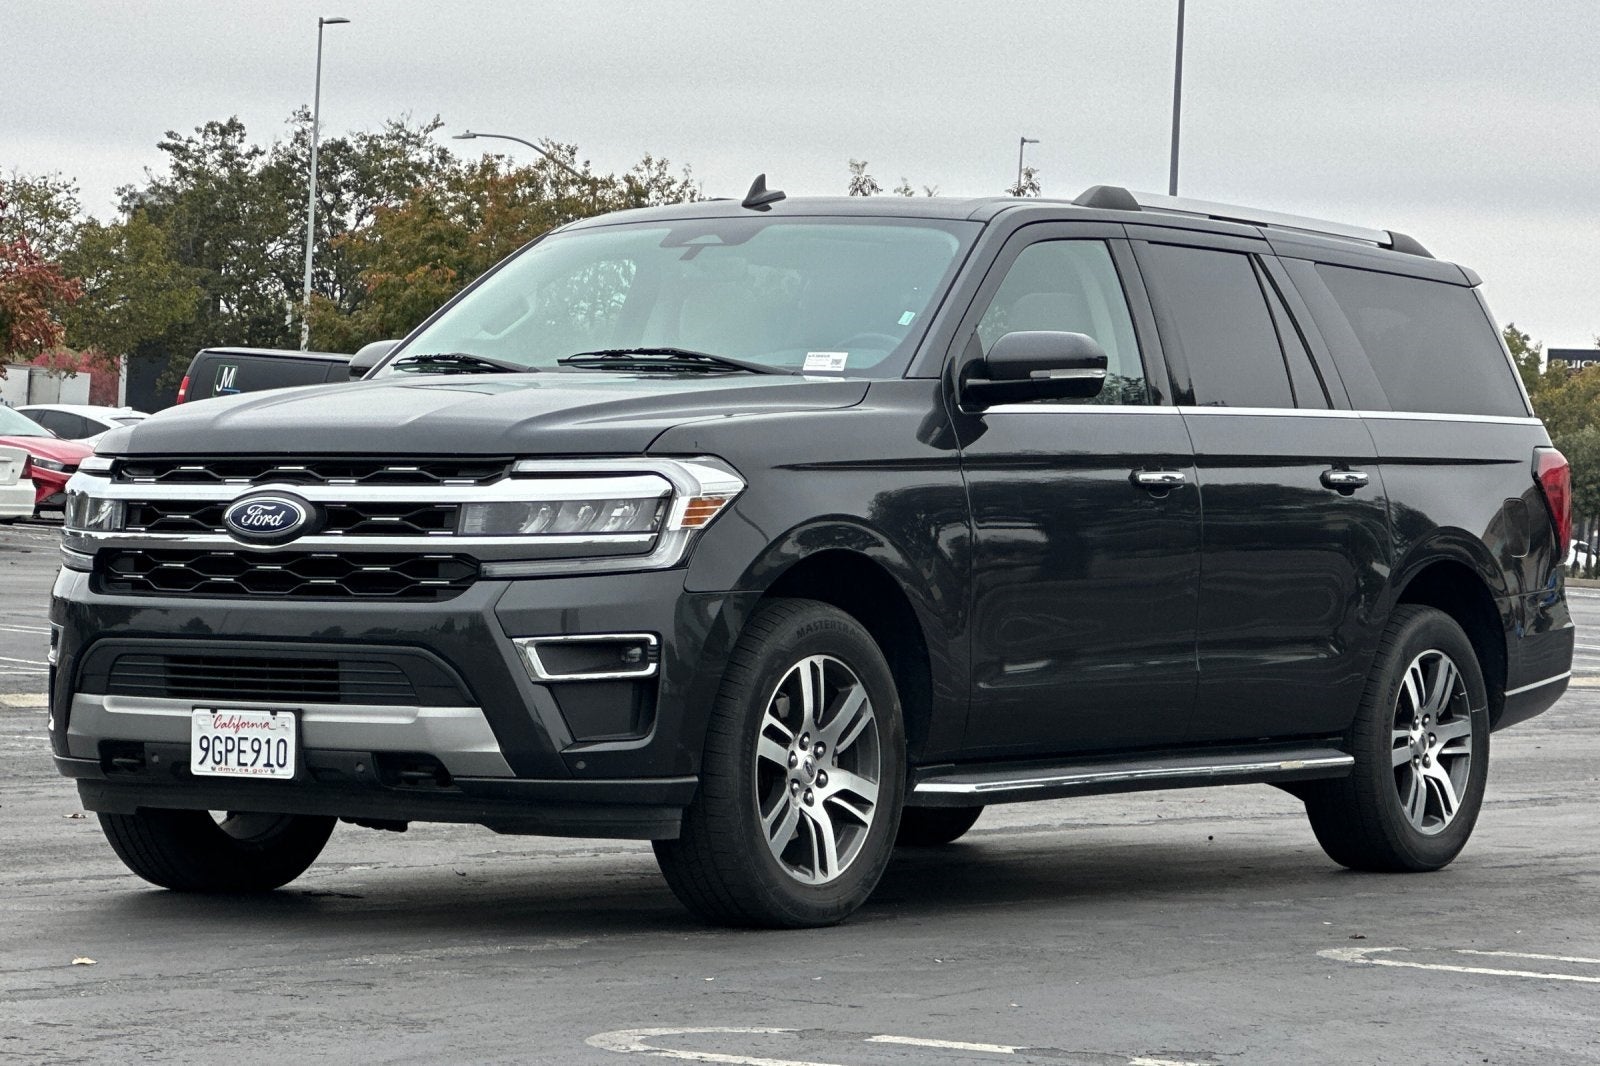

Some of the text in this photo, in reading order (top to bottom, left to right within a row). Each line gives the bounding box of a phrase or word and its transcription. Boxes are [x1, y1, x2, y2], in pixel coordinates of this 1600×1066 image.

[241, 504, 286, 526] Ford
[213, 714, 277, 734] California
[198, 735, 288, 768] 9GPE910
[217, 767, 270, 775] dmv.ca.gov
